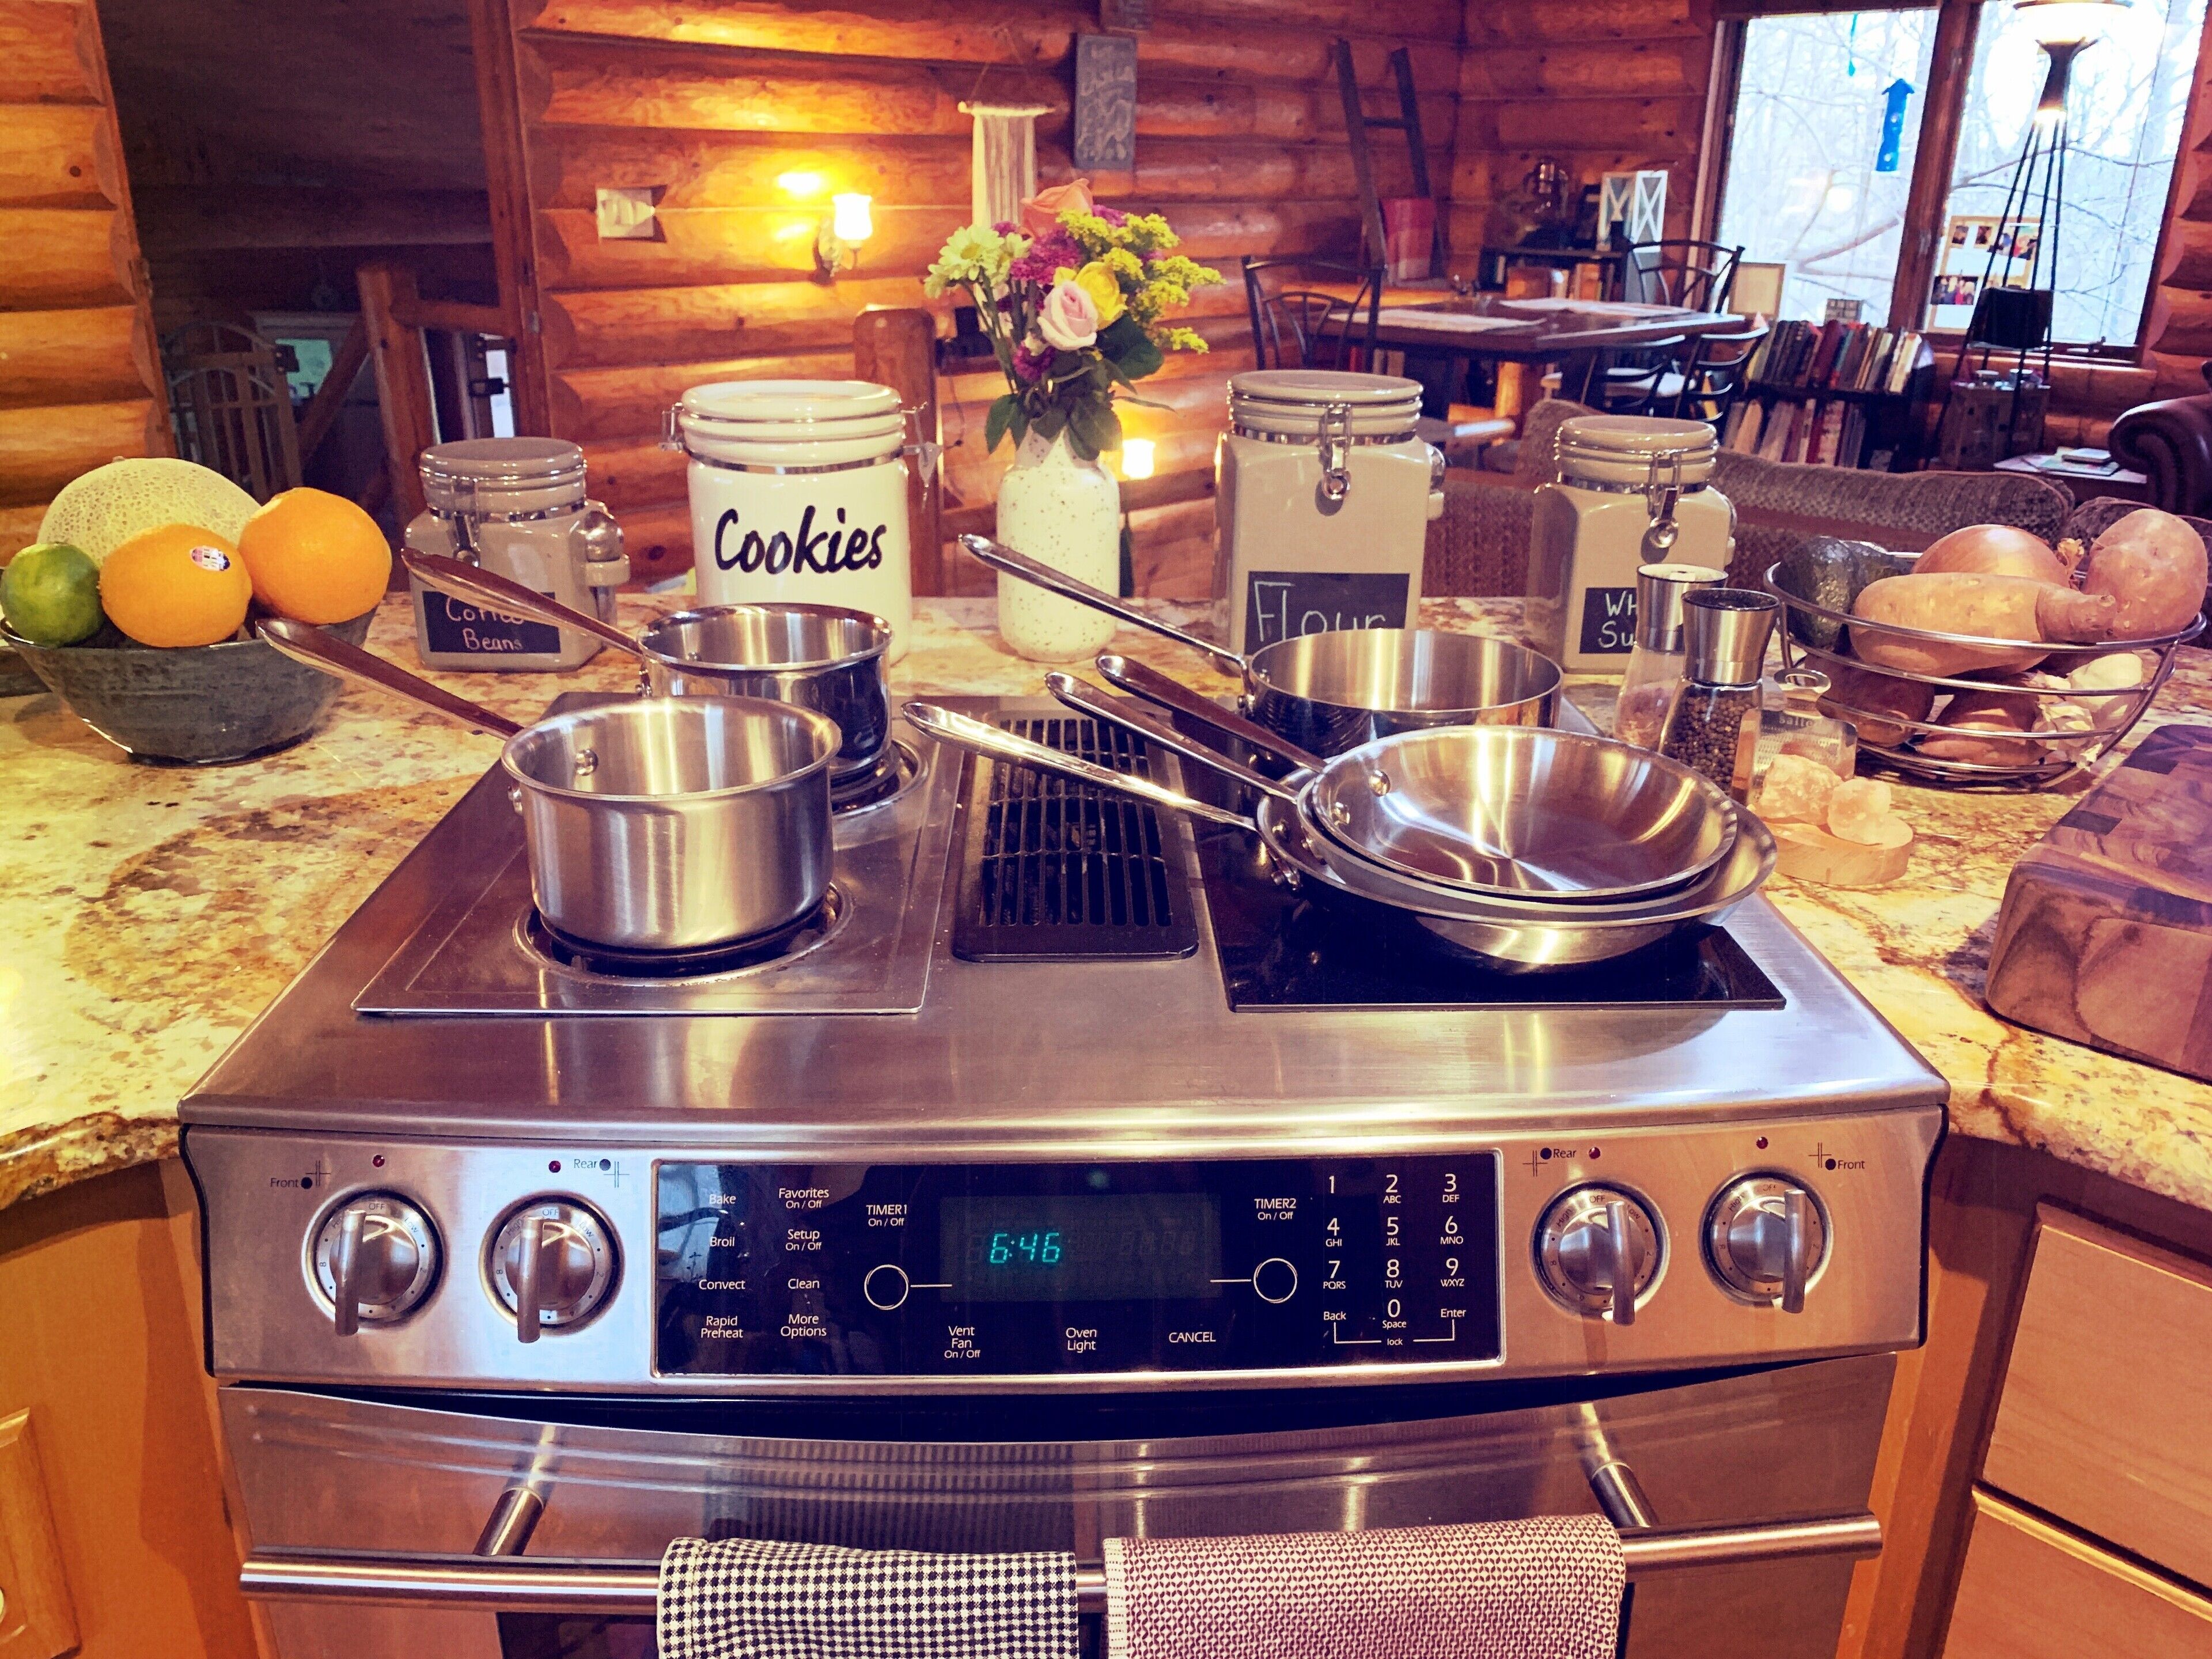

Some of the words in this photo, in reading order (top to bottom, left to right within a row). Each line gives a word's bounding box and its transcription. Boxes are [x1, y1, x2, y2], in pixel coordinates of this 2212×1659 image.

[714, 505, 888, 575] Cookies
[462, 627, 524, 652] Beans
[1553, 1148, 1577, 1158] Rear
[573, 1158, 598, 1169] Rear
[1838, 1160, 1866, 1169] Front
[270, 1177, 299, 1188] Front
[1328, 1175, 1335, 1194] 1
[1385, 1174, 1398, 1194] 2
[1444, 1173, 1457, 1192] 3
[709, 1193, 737, 1205] Bake
[778, 1187, 830, 1199] Favorites
[1442, 1194, 1460, 1203] DEF
[1253, 1198, 1297, 1210] TIMER2
[1382, 1195, 1402, 1204] ABC
[865, 1203, 908, 1215] TIMER1
[1327, 1217, 1340, 1236] 4
[1387, 1217, 1399, 1236] 5
[1445, 1215, 1458, 1234] 6
[787, 1228, 820, 1241] Setup
[1440, 1235, 1464, 1245] MNO
[710, 1236, 736, 1247] Broil
[1325, 1238, 1343, 1247] GHI
[1385, 1237, 1401, 1247] JKL
[989, 1233, 1061, 1264] 6:46
[1328, 1260, 1340, 1279] 7
[1386, 1259, 1400, 1278] 8
[1445, 1257, 1459, 1277] 9
[698, 1278, 746, 1290] Convect
[787, 1278, 820, 1290] Clean
[1323, 1281, 1346, 1290] PQRS
[1384, 1279, 1403, 1289] TUV
[1440, 1278, 1465, 1287] WXYZ
[1387, 1298, 1401, 1318] 0
[1440, 1308, 1467, 1318] Enter
[788, 1313, 820, 1325] More
[1323, 1310, 1347, 1321] Back
[706, 1315, 738, 1329] Rapid
[1382, 1320, 1407, 1330] Space
[700, 1327, 744, 1339] Preheat
[780, 1325, 828, 1340] Options
[948, 1325, 976, 1336] Vent
[1065, 1327, 1097, 1339] Oven
[951, 1337, 972, 1349] Fan
[1168, 1331, 1217, 1343] CANCEL
[1387, 1336, 1403, 1346] lock
[1067, 1339, 1098, 1354] Light
